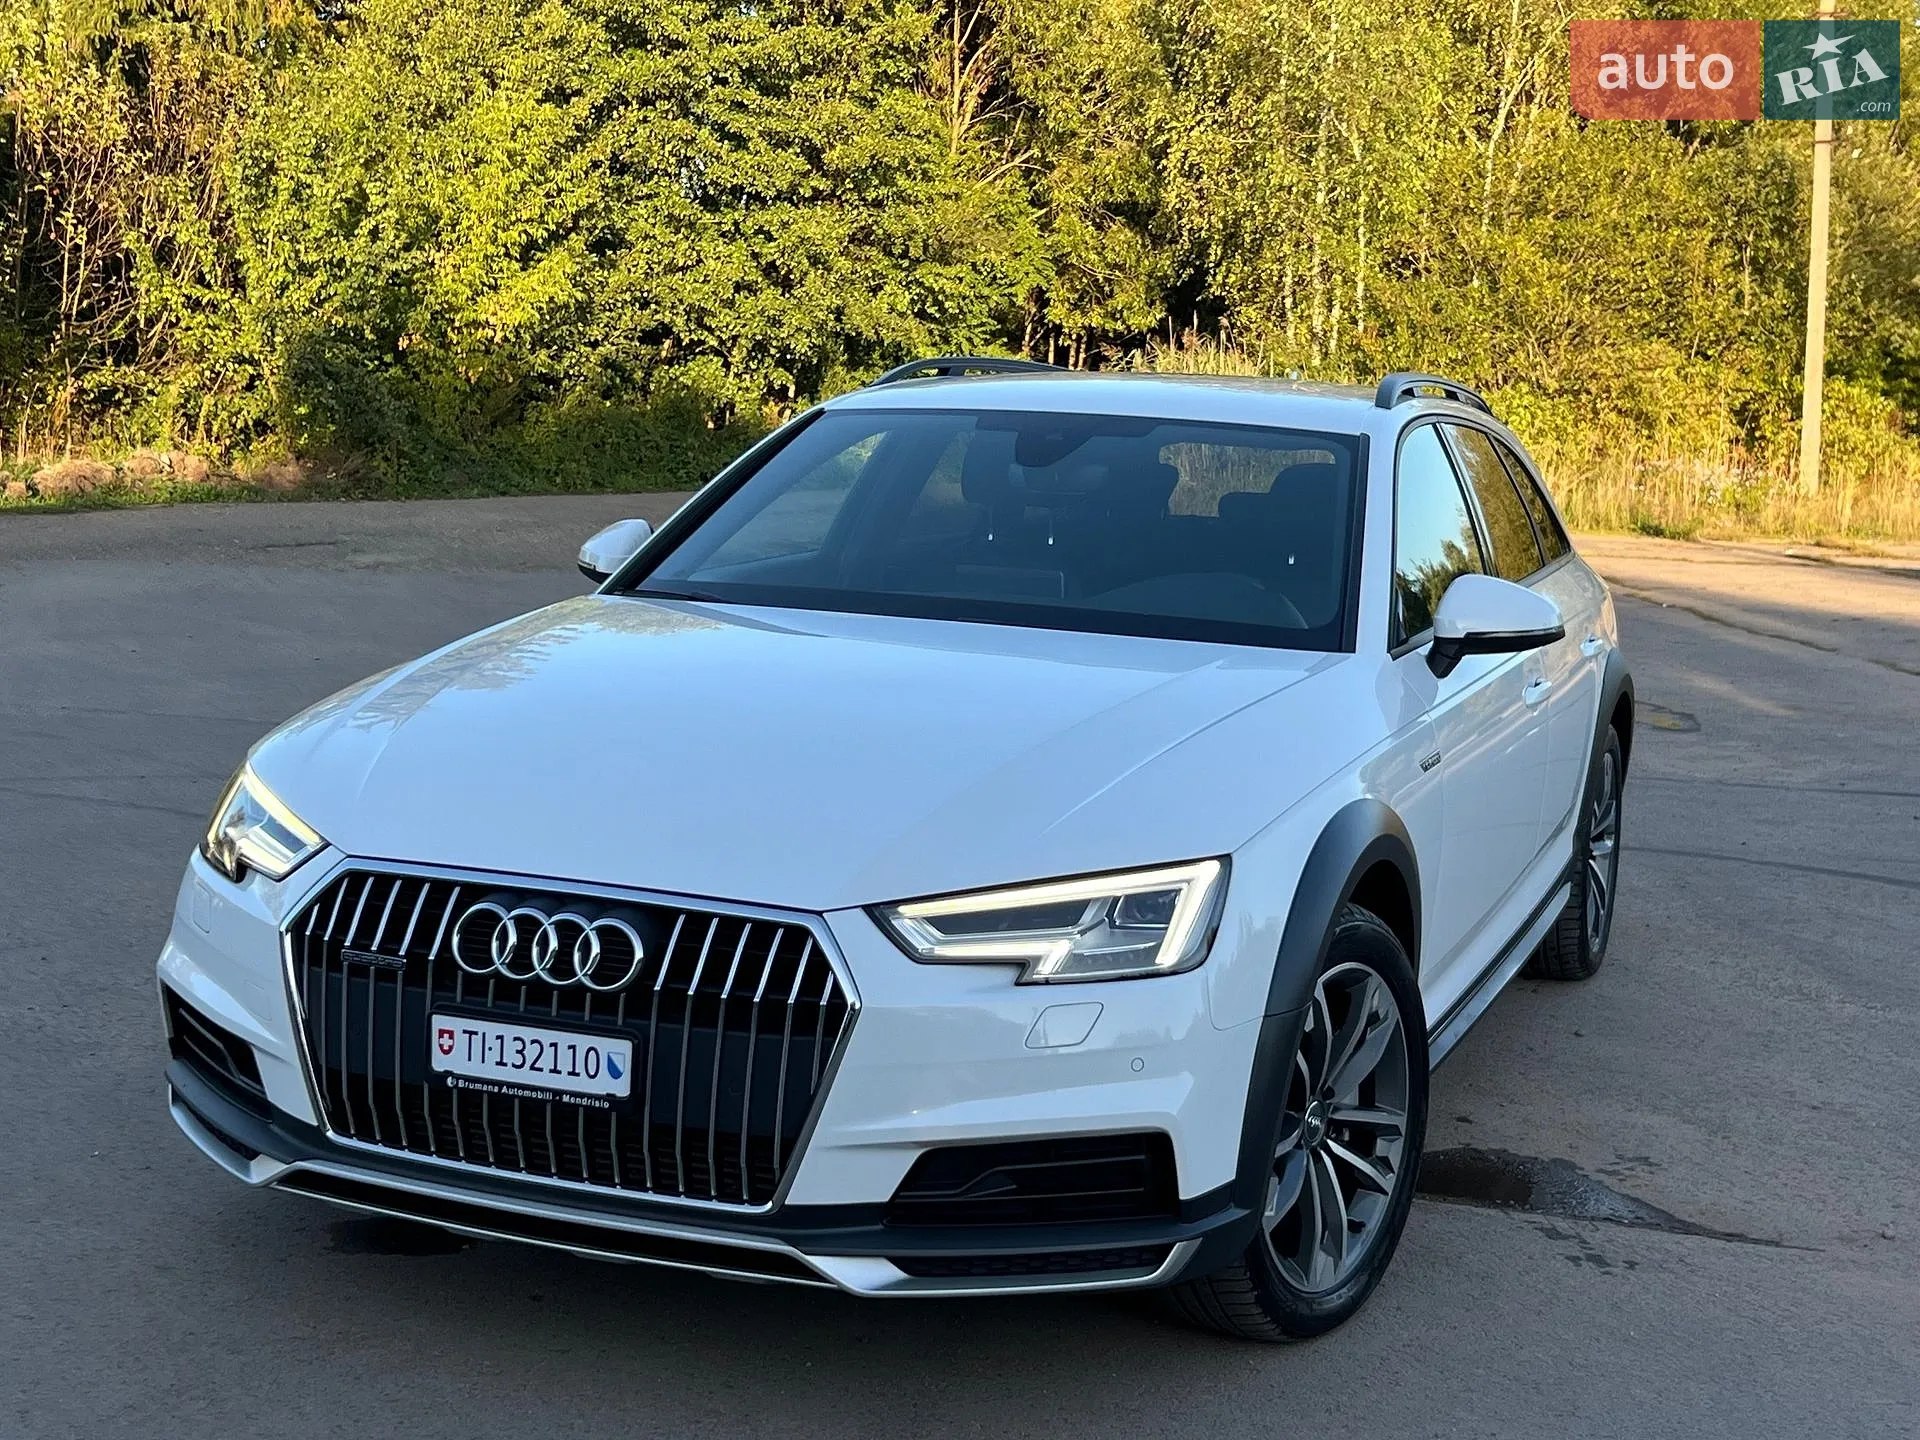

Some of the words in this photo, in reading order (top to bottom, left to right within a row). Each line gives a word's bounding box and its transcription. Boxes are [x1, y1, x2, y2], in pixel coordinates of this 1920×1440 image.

[458, 1079, 499, 1093] Brumana
[501, 1085, 553, 1100] Automobili
[562, 1094, 610, 1109] Mendrisio
